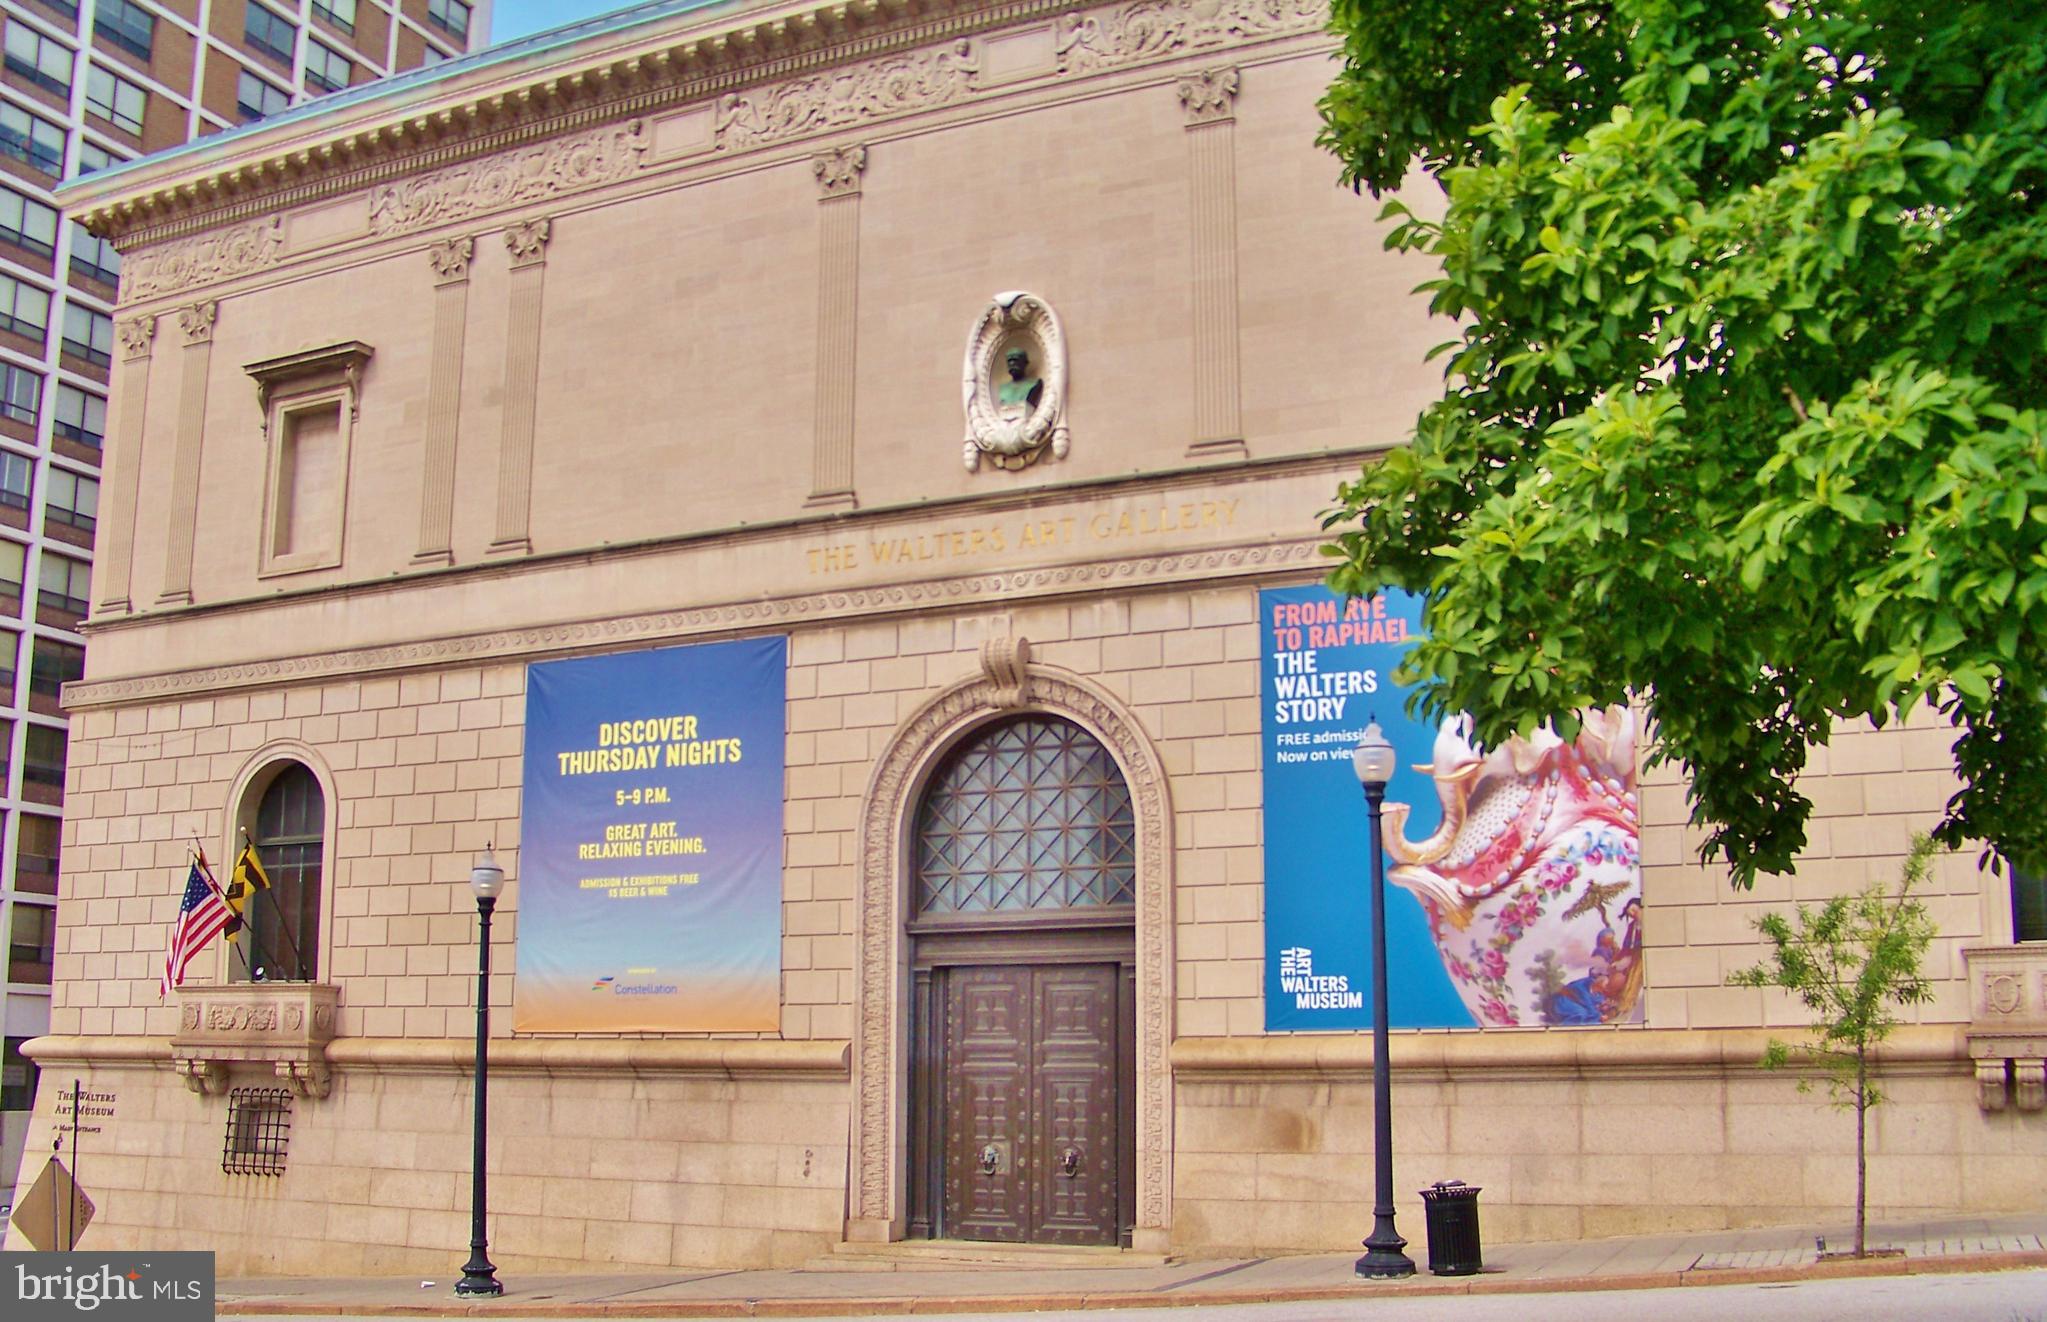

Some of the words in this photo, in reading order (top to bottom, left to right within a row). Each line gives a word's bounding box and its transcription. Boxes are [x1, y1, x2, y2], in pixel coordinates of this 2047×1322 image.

[806, 544, 858, 575] THE
[869, 525, 1006, 565] WALTERS
[1017, 517, 1077, 549] ART
[1089, 498, 1241, 540] GALLERY
[1273, 601, 1337, 628] FROM
[1344, 595, 1387, 622] RYE
[1273, 627, 1302, 651] TO
[1308, 618, 1409, 649] RAPHAEL
[1273, 650, 1317, 675] THE
[1274, 669, 1378, 700] WALTERS
[1275, 697, 1347, 724] STORY
[599, 715, 698, 747] DISCOVER
[1277, 732, 1311, 746] FREE
[558, 745, 661, 776] THURSDAY
[666, 738, 742, 767] NIGHTS
[1277, 750, 1308, 763] Now
[1310, 750, 1328, 761] on
[645, 787, 671, 804] P.M.
[606, 823, 647, 841] GREAT
[650, 821, 678, 839] ART.
[579, 841, 642, 860] RELAXING
[646, 837, 707, 857] EVENING.
[580, 877, 621, 889] ADMISSION
[679, 872, 699, 884] FREE
[619, 887, 639, 897] BEER
[1280, 947, 1296, 977] THE
[1296, 947, 1312, 977] ART
[615, 983, 678, 995] Constellation
[1280, 976, 1349, 993] WALTERS
[1296, 991, 1363, 1009] MUSEUM
